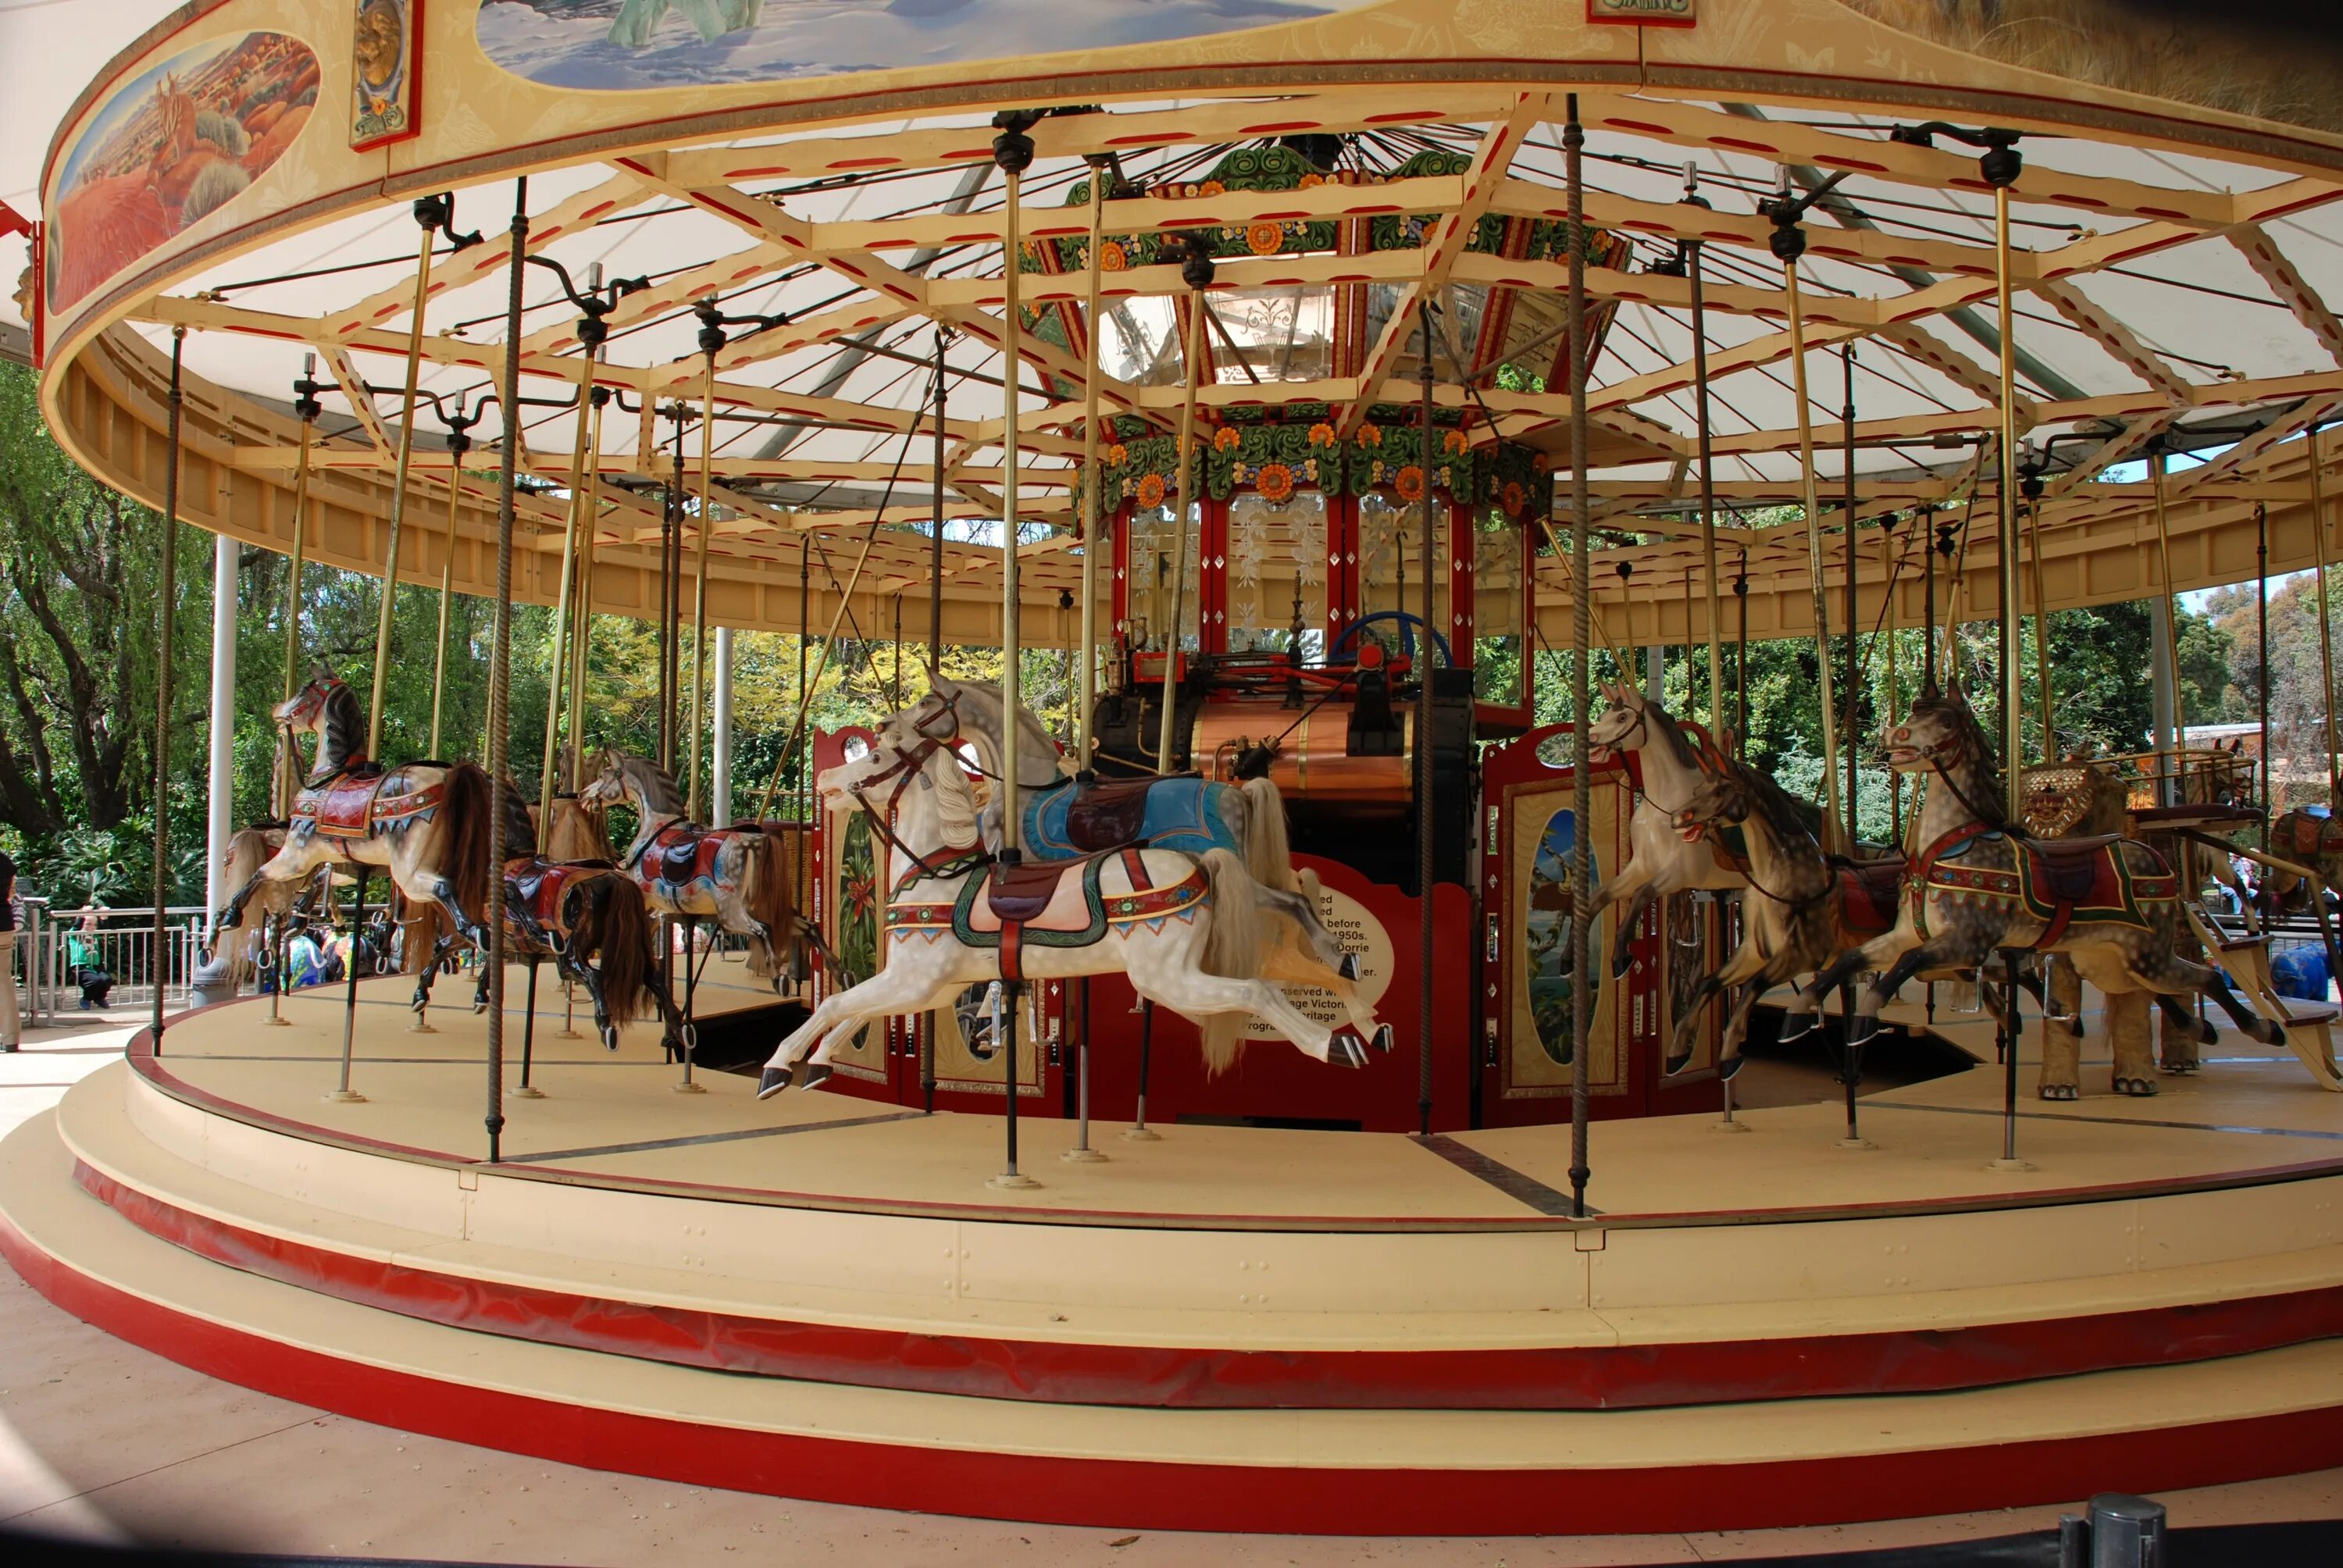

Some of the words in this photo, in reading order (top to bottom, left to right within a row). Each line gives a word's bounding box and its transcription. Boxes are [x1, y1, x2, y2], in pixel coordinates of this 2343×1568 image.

[1327, 919, 1361, 928] before
[1338, 943, 1369, 952] Dorrie
[1289, 1000, 1308, 1010] age
[1311, 999, 1346, 1008] Victori
[1303, 1011, 1336, 1022] ritage
[1248, 1023, 1277, 1032] rogra
